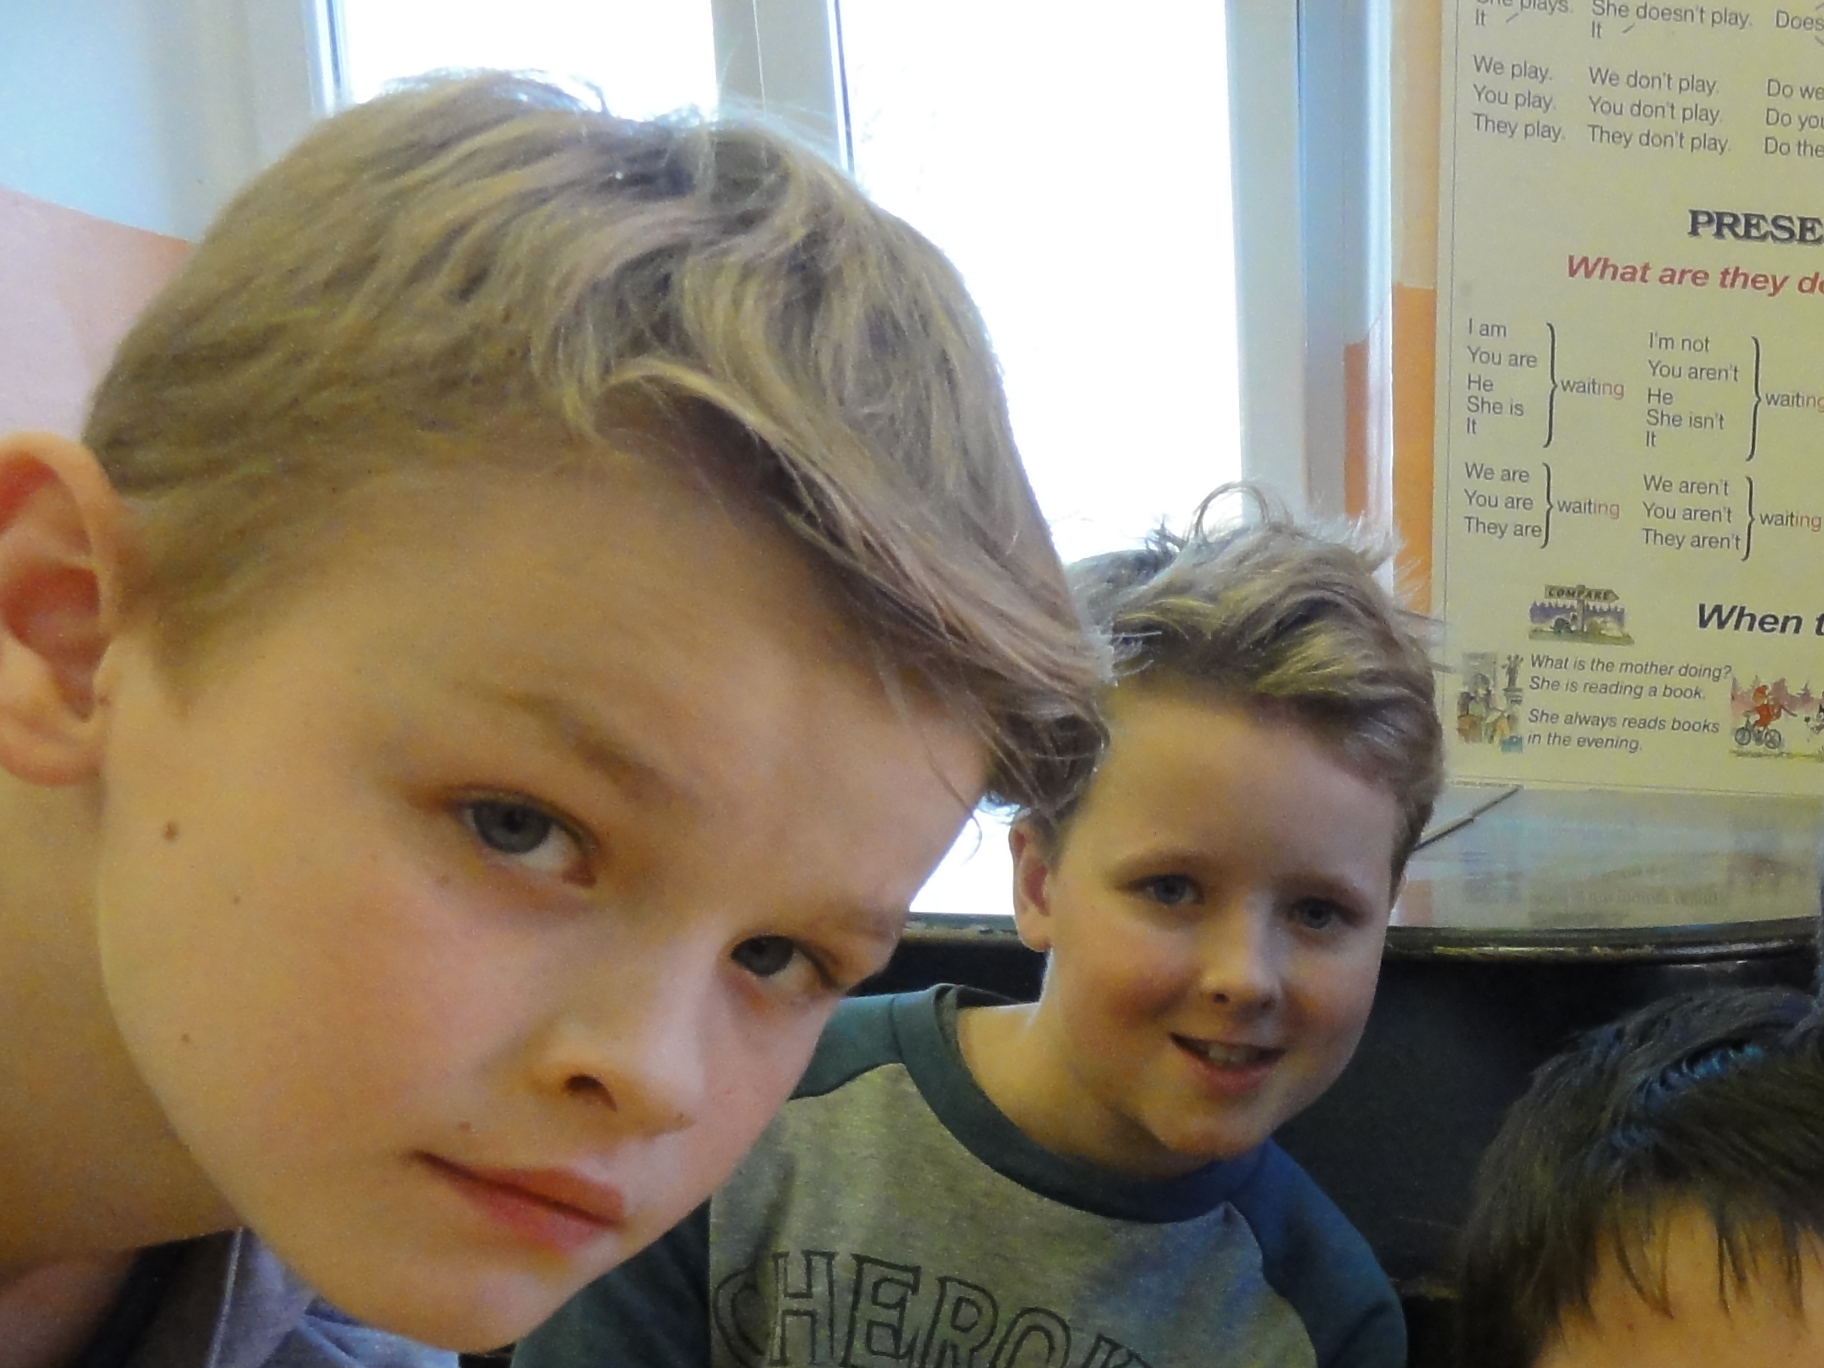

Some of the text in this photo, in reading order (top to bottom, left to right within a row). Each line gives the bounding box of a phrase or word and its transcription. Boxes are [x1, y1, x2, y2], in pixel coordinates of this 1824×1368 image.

[1568, 255, 1651, 283] What
[1658, 267, 1709, 287] are
[1719, 266, 1790, 297] they
[1561, 378, 1624, 398] waiting
[1557, 499, 1620, 520] waiting
[1760, 511, 1821, 532] waiting
[1699, 603, 1803, 634] When
